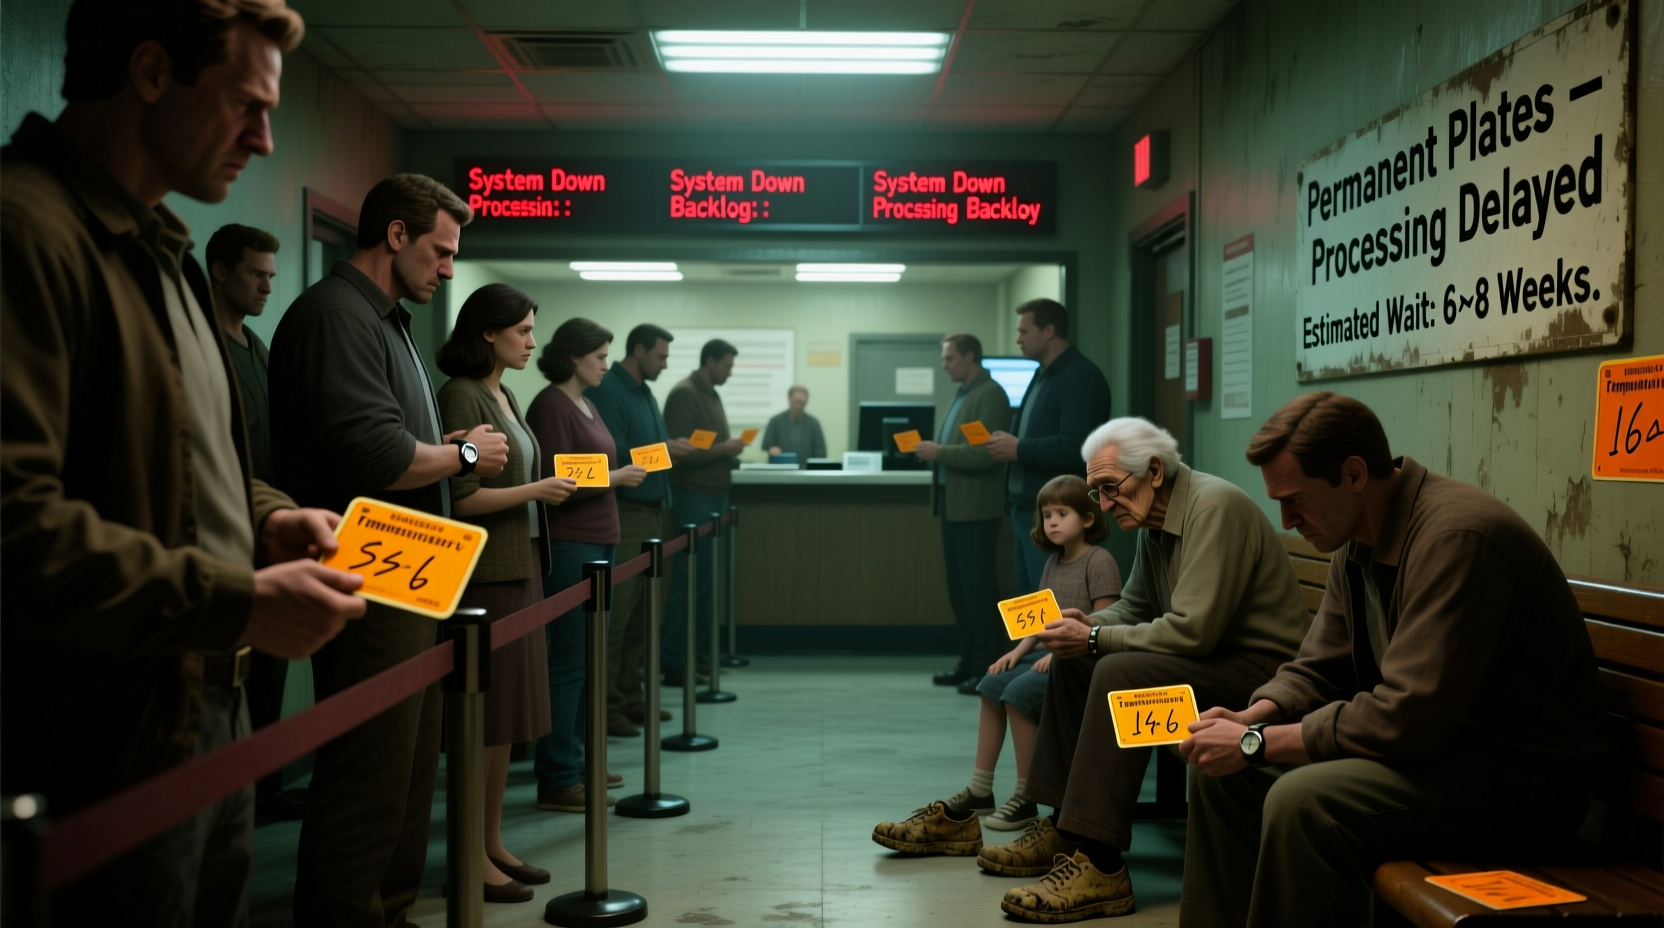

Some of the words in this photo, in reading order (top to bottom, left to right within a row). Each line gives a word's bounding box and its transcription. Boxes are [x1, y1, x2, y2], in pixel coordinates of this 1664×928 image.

[469, 167, 544, 196] System
[551, 168, 606, 191] Down
[670, 168, 744, 198] System
[751, 169, 805, 192] Down
[873, 170, 946, 198] System
[953, 171, 1005, 193] Down
[1308, 125, 1438, 227] Permanent
[1449, 84, 1555, 171] Plates
[1312, 206, 1447, 286] Processing
[1459, 133, 1603, 242] Delayed
[1303, 301, 1379, 349] Estimated
[1386, 291, 1436, 335] Wait:
[1497, 258, 1601, 316] Weeks.
